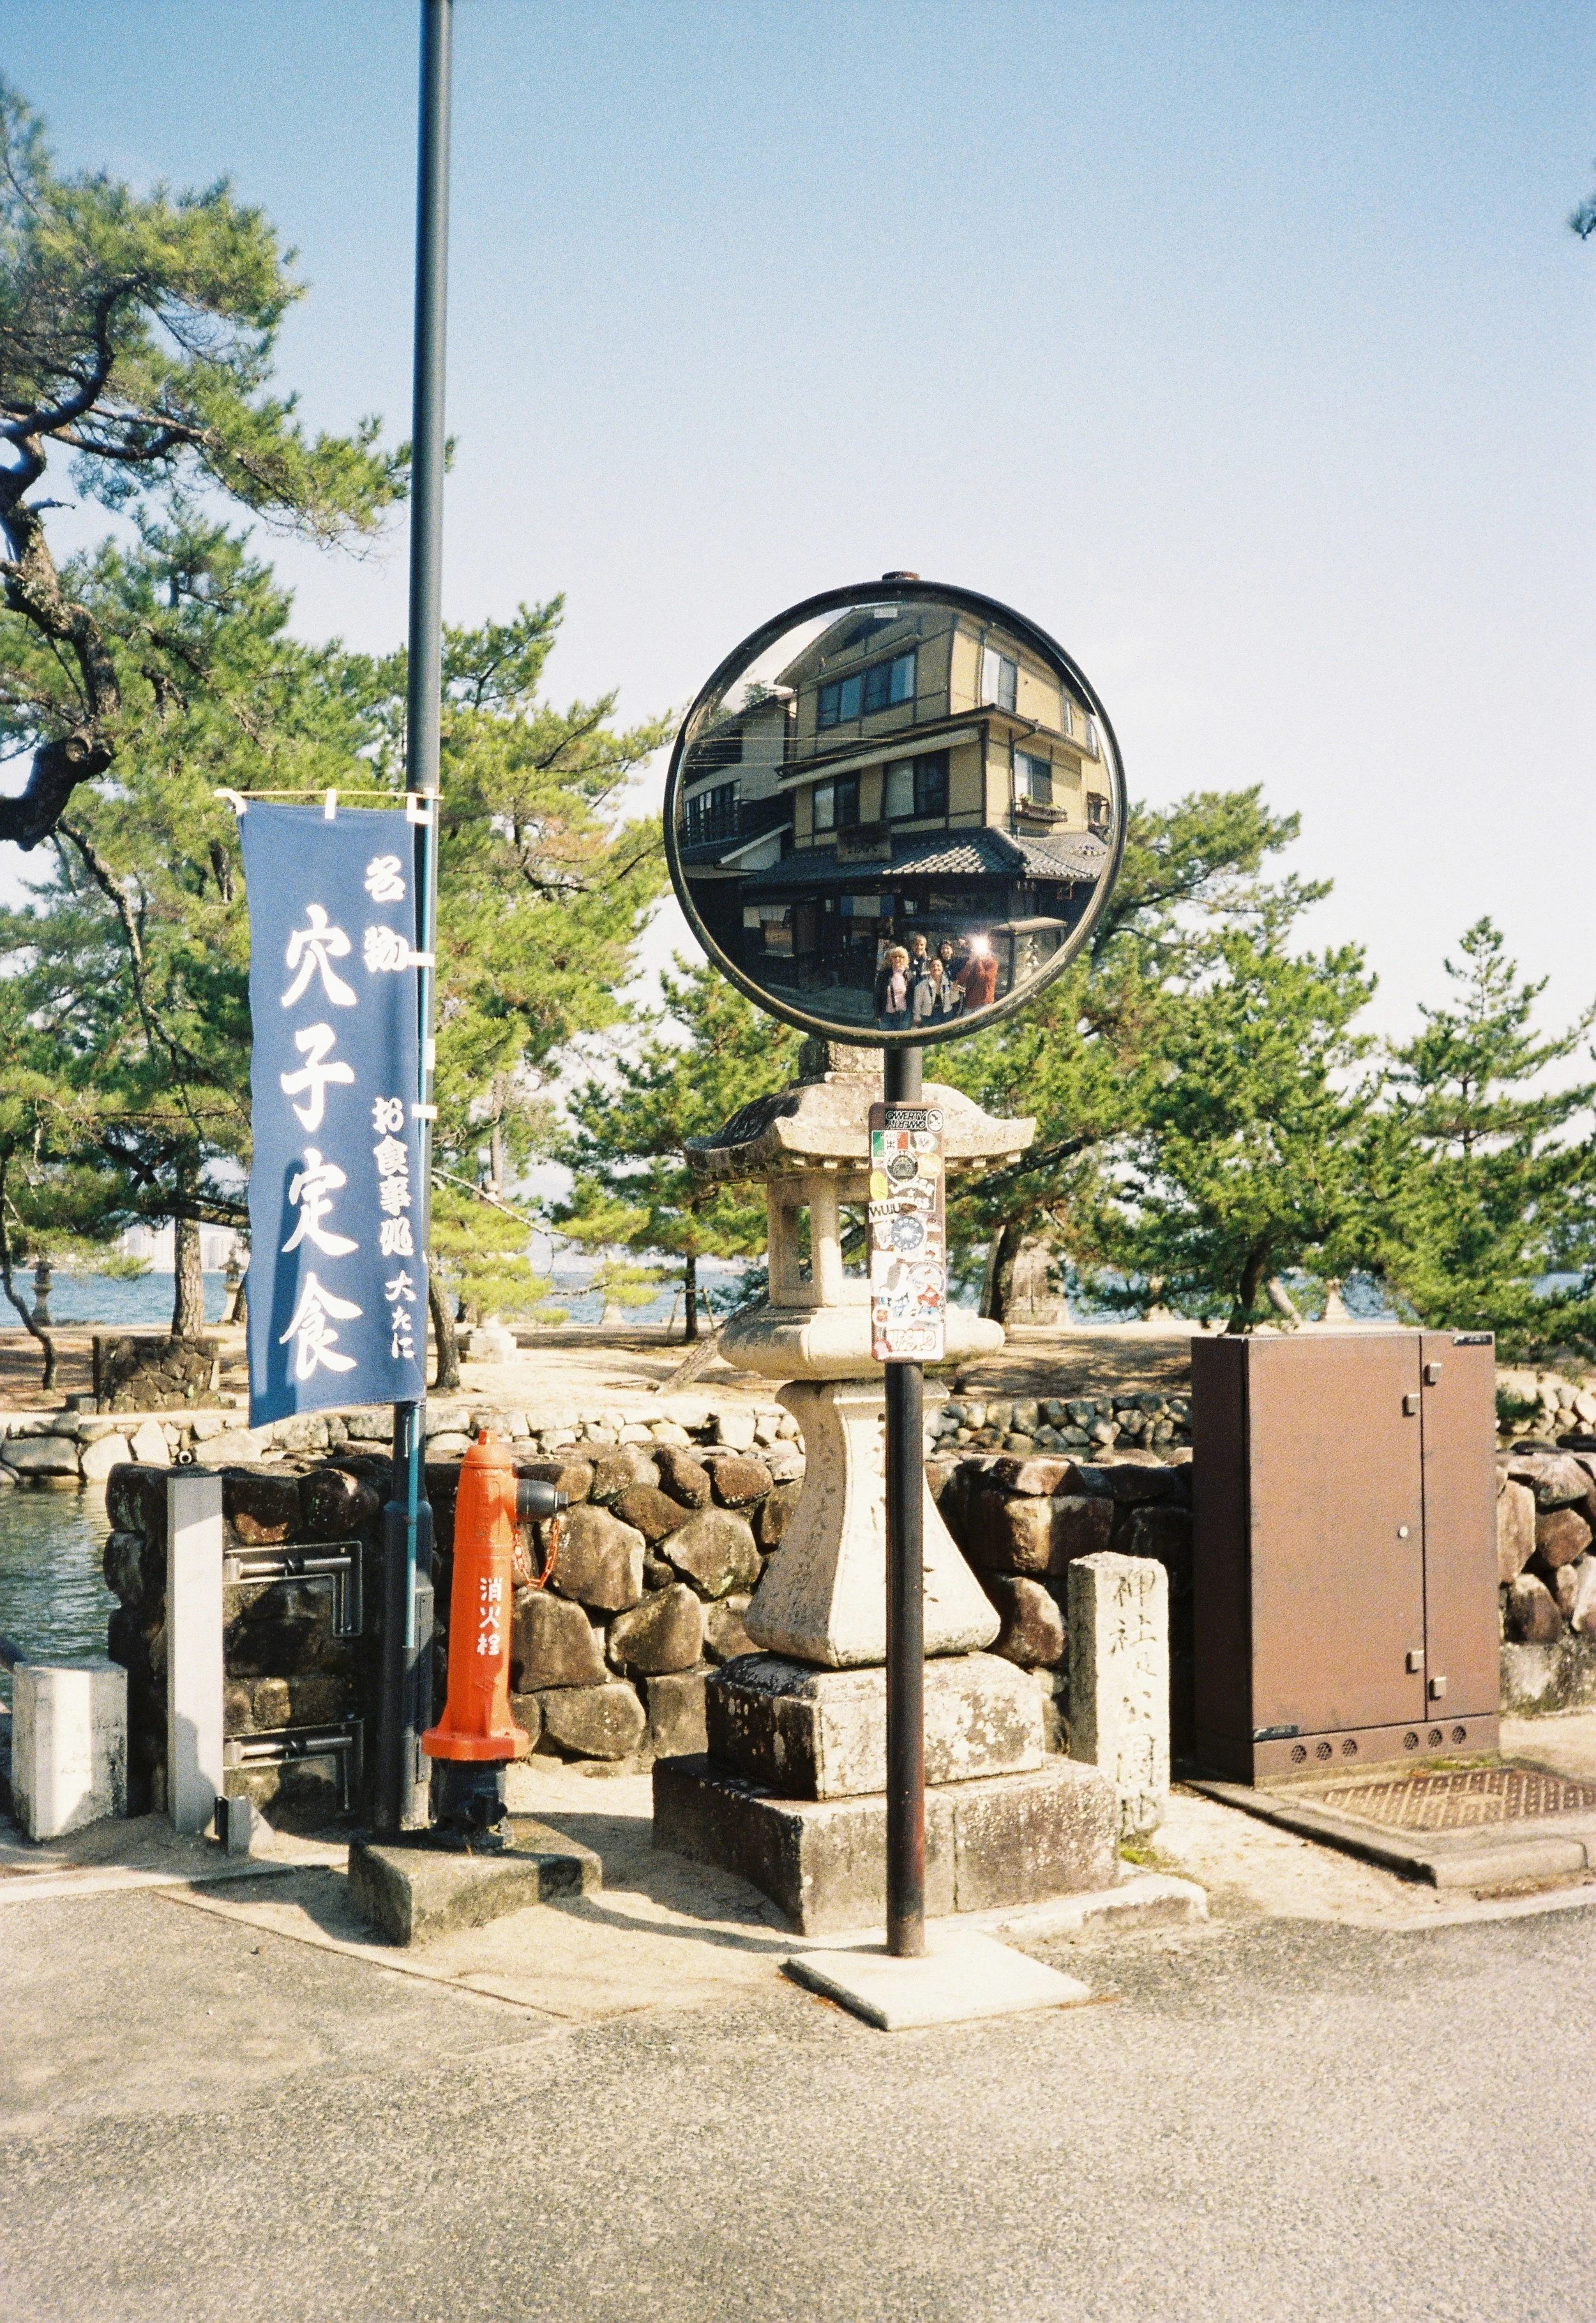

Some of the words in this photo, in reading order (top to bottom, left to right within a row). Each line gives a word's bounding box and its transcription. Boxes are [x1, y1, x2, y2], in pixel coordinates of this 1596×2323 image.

[280, 902, 364, 1381] 穴子定食
[885, 1110, 927, 1121] QWERTY
[372, 1096, 414, 1257] お食事処
[385, 1269, 418, 1359] 大たに
[477, 1575, 504, 1656] 消火栓
